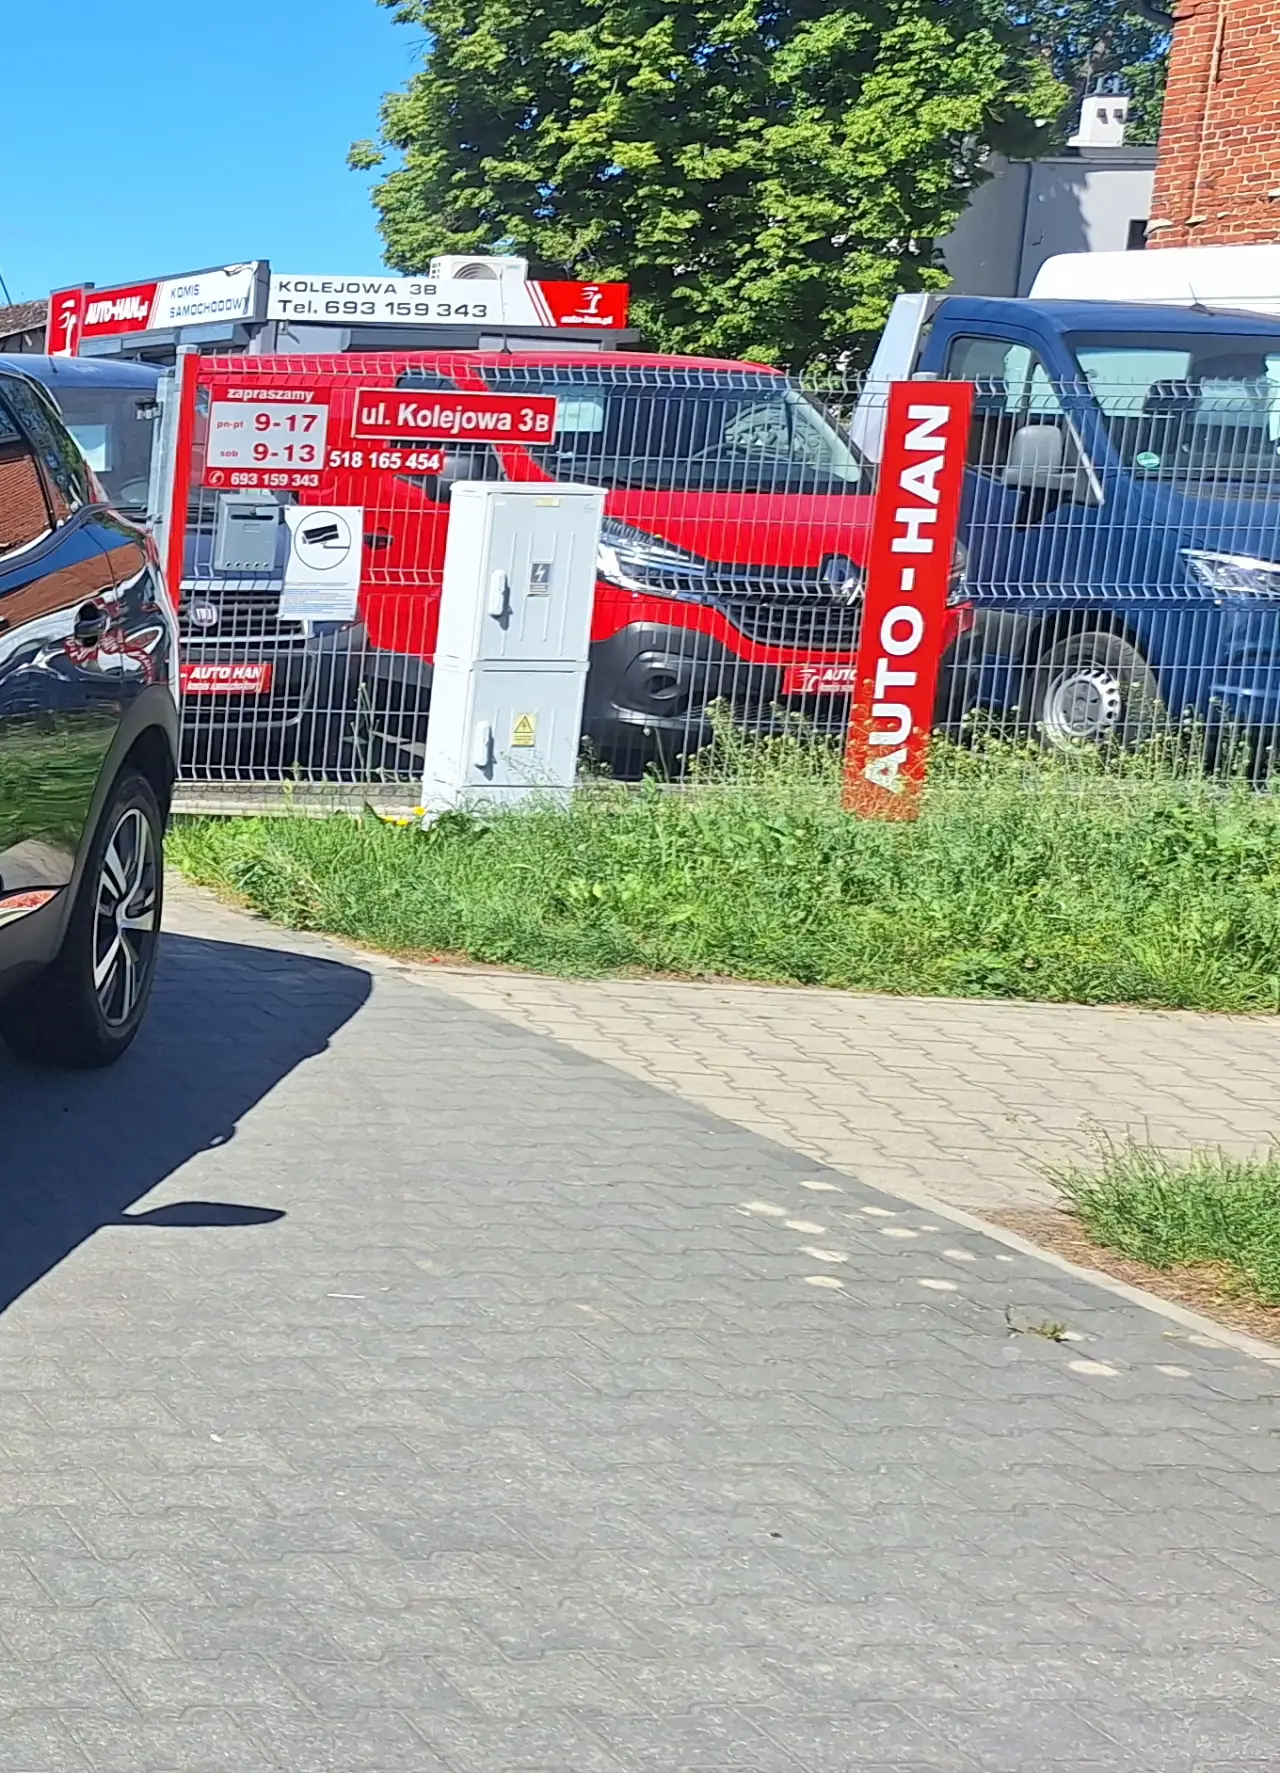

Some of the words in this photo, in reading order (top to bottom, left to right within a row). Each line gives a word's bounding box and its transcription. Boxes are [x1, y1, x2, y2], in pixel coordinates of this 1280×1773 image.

[171, 284, 200, 299] KOMIS
[278, 281, 397, 294] KOLEJOWA
[409, 284, 437, 295] 3B
[278, 300, 317, 314] Tel.
[325, 301, 375, 315] 693
[386, 303, 430, 316] 159
[436, 304, 487, 318] 343
[227, 388, 314, 403] zapraszamy
[217, 420, 244, 429] pn-pt
[254, 413, 319, 432] 9-17
[361, 404, 390, 425] ul.
[397, 403, 511, 434] Kolejowa
[518, 408, 549, 432] 3B
[252, 443, 315, 462] 9-13
[329, 450, 363, 468] 518
[369, 451, 401, 469] 165
[405, 453, 440, 470] 454
[230, 472, 258, 485] 693
[262, 473, 289, 486] 159
[292, 473, 319, 487] 343
[190, 666, 231, 679] AUTO
